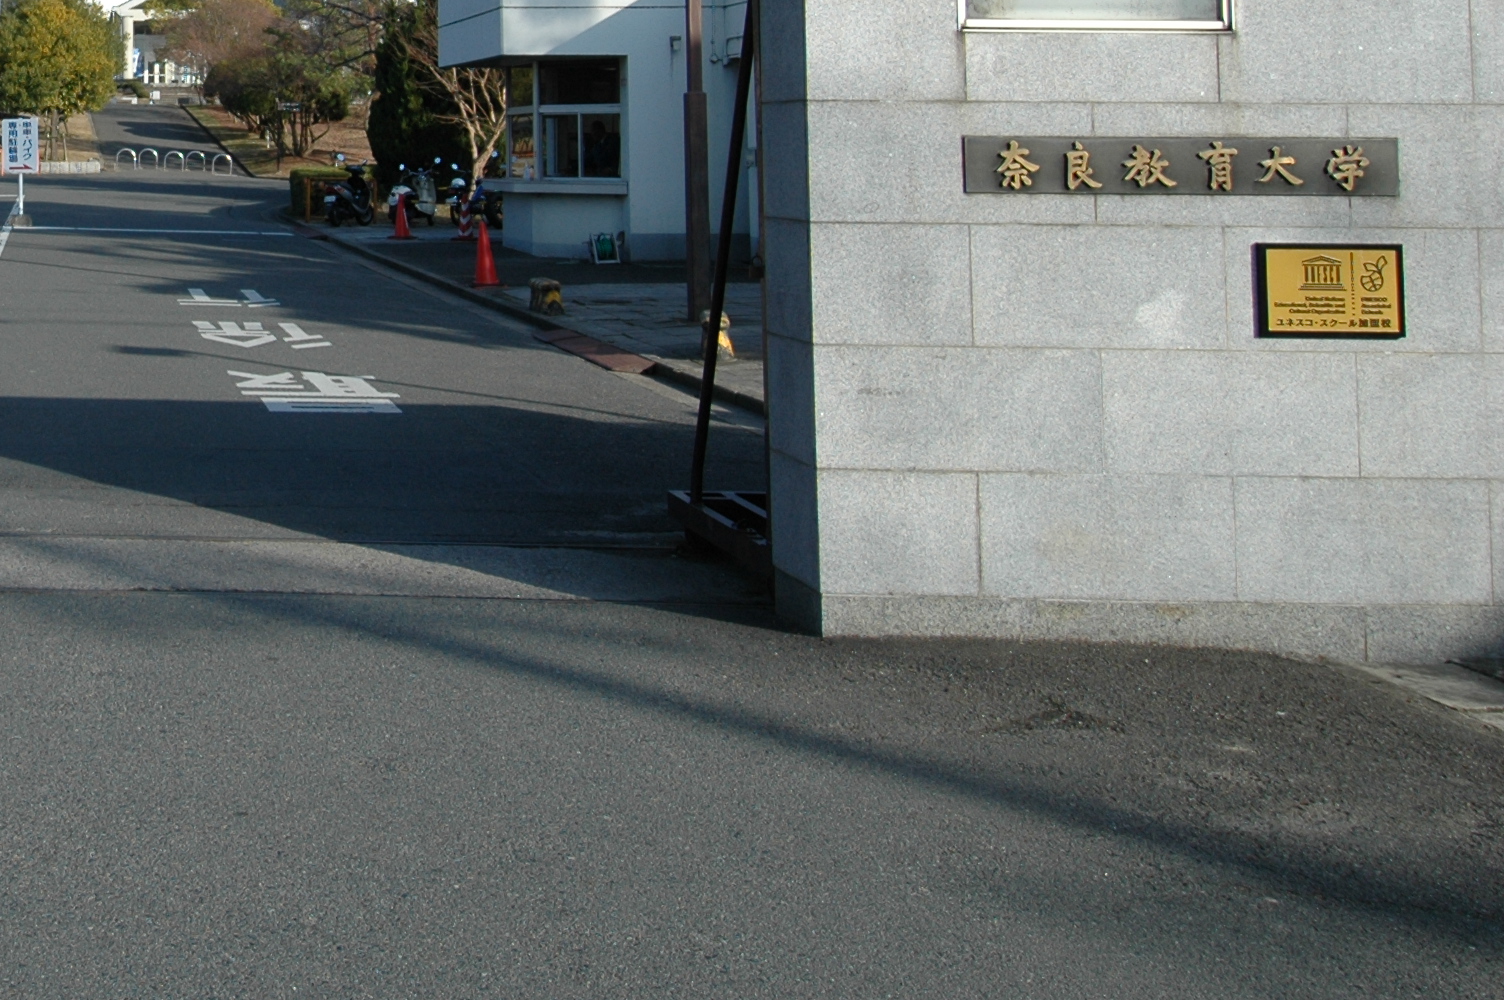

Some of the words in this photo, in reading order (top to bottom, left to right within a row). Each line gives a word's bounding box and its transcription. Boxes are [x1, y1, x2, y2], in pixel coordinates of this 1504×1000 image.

[996, 140, 1370, 190] 奈良教育大学
